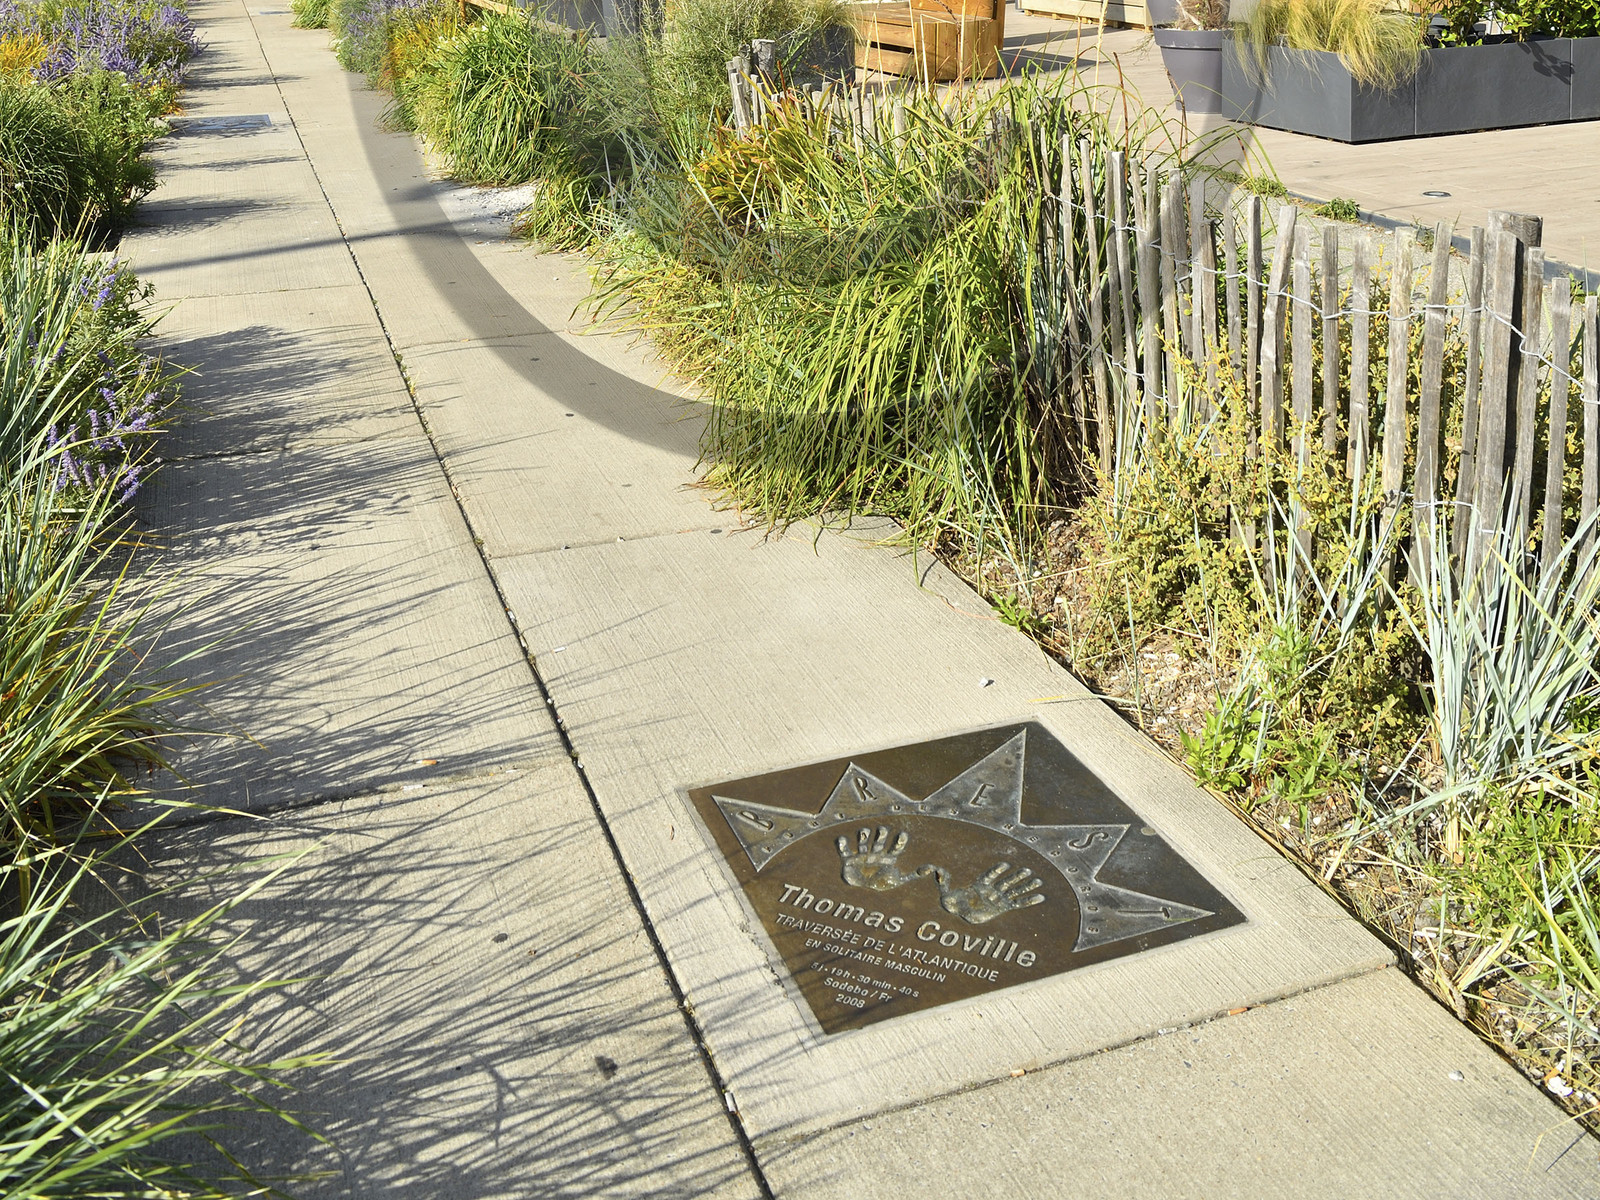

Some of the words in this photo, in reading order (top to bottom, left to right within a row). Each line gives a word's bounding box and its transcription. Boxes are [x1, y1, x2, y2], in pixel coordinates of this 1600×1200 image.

[777, 883, 905, 934] Thomas
[916, 920, 1038, 969] Coville
[776, 913, 862, 945] TRAVERSÉE
[863, 936, 884, 951] DE
[889, 945, 1000, 983] L'ATLANTIQUE
[805, 938, 822, 949] EN
[823, 943, 883, 967] SOLITAIRE
[884, 959, 947, 984] MASCULIN
[824, 977, 869, 997] Sodebo
[879, 991, 893, 1002] Fr
[835, 993, 866, 1009] 2008
[872, 979, 891, 990] min
